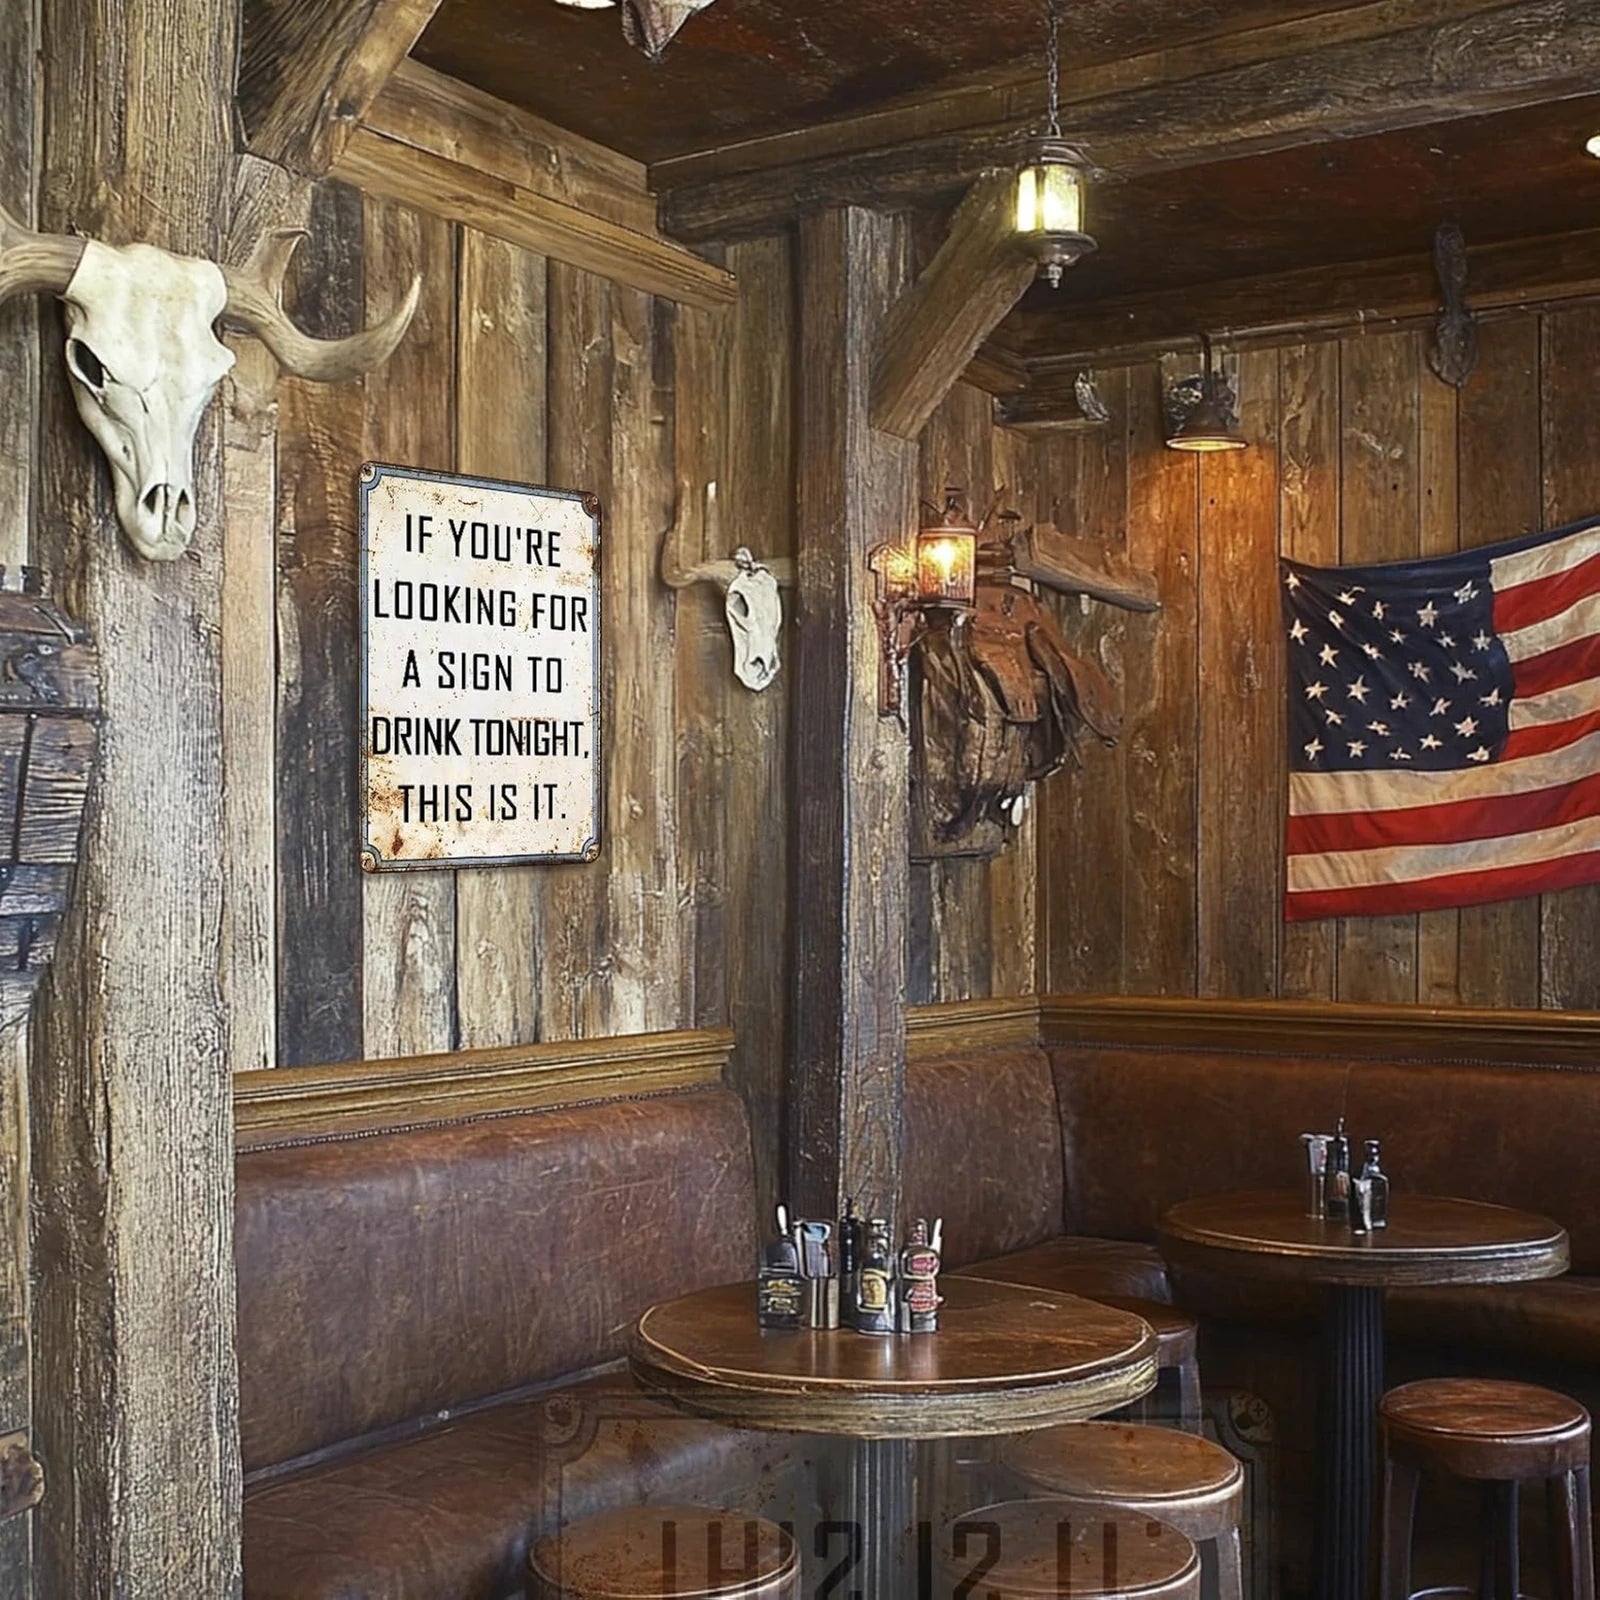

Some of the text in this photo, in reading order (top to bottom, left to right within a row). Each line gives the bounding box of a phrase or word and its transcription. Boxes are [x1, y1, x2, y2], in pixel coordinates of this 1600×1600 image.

[405, 514, 561, 568] IF YOU'RE
[374, 579, 587, 633] LOOKING FOR
[402, 649, 562, 693] A SIGN TO
[372, 716, 589, 759] DRINK TONIGHT,
[397, 783, 566, 823] THIS IS IT.
